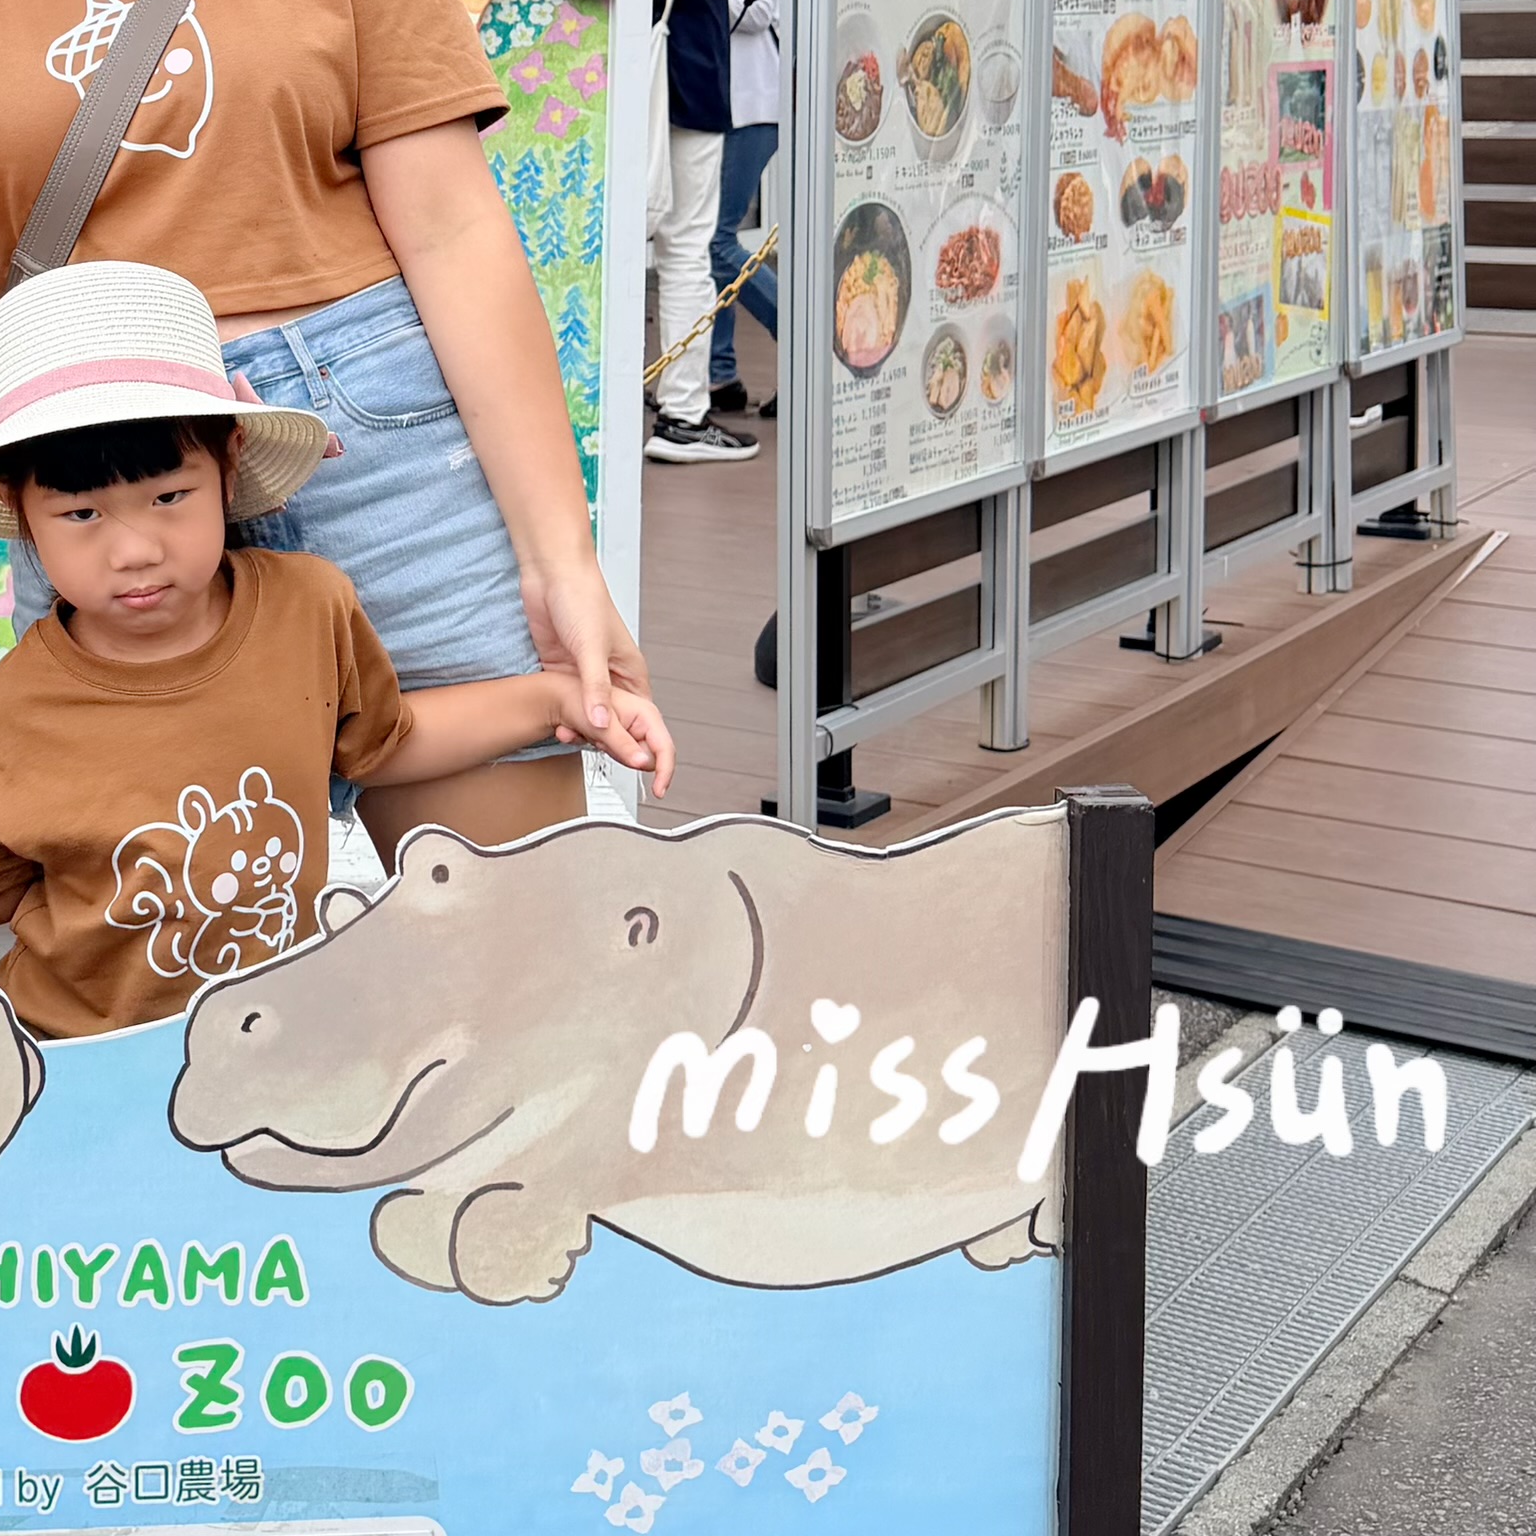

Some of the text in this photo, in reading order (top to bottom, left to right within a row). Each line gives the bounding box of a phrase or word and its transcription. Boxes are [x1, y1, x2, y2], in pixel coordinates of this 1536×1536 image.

[175, 1340, 412, 1431] ZOO
[16, 1472, 62, 1509] by
[85, 1458, 262, 1505] 谷口農場
